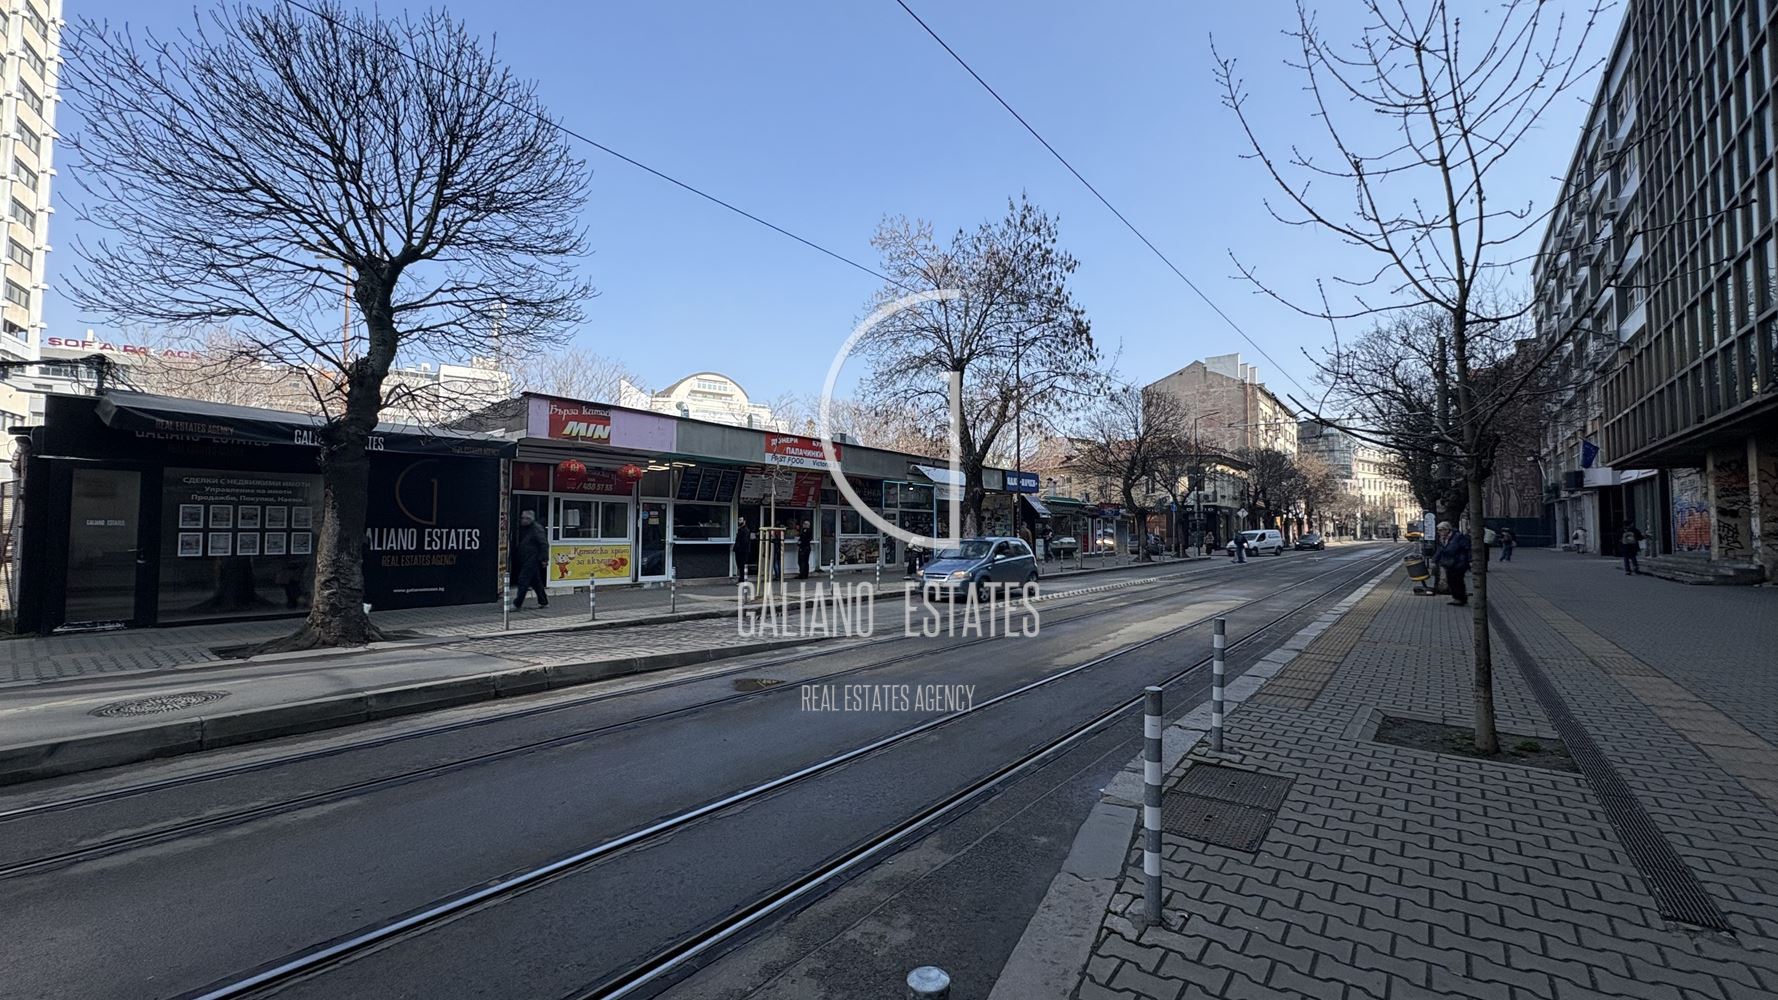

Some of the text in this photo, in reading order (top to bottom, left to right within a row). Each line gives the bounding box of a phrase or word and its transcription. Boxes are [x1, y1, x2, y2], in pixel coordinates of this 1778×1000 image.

[48, 337, 115, 351] SOFA
[176, 422, 206, 433] ESTATES
[562, 421, 611, 439] MIN
[786, 446, 824, 458] ПАЛАЧИНКИ
[788, 457, 804, 465] FOOD
[366, 528, 480, 551] ALIANO ESTATES
[382, 554, 457, 567] REAL ESTATES AGENCY
